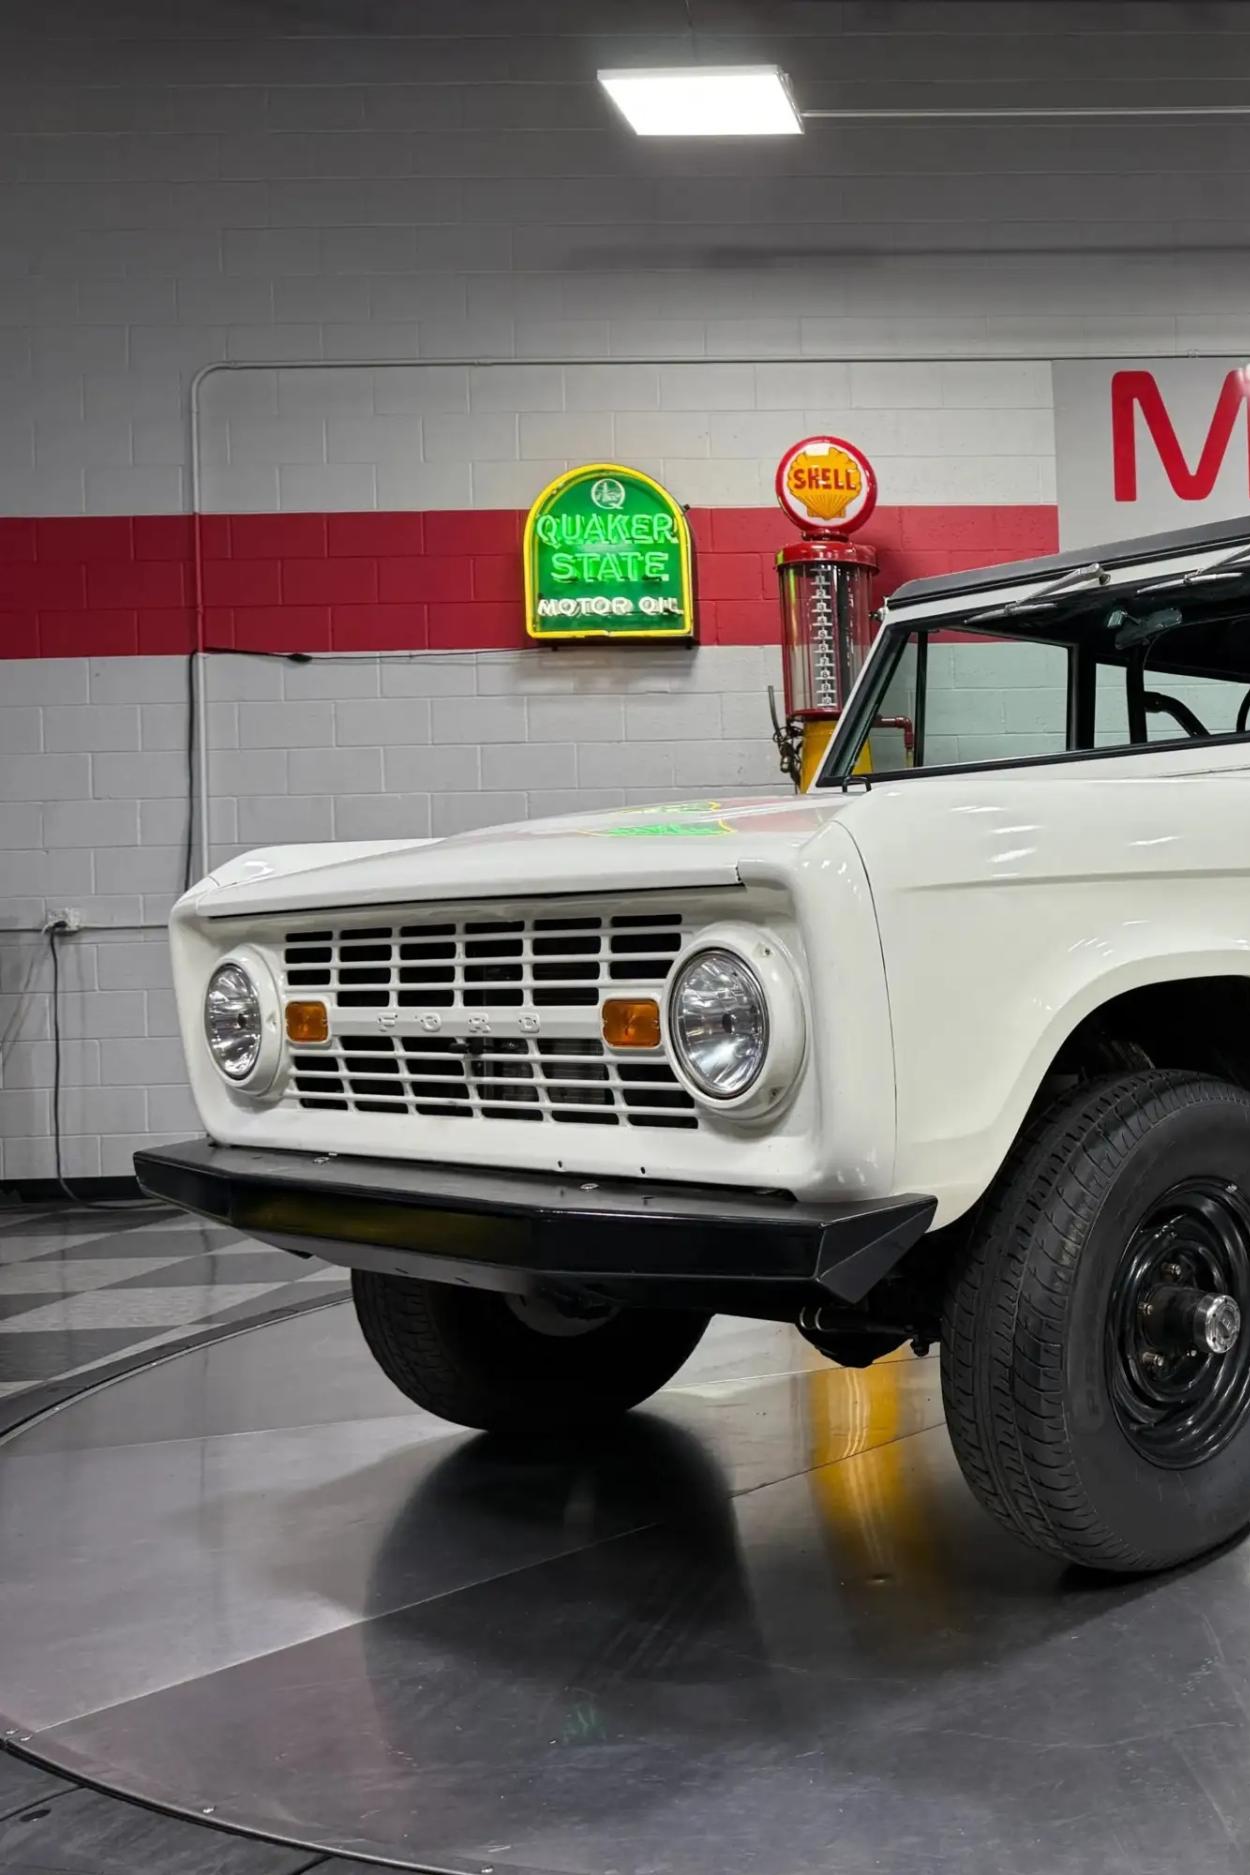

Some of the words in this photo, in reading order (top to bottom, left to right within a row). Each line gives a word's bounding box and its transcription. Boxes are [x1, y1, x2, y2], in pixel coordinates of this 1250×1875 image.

[793, 467, 856, 491] SHELL
[536, 513, 679, 549] QUAKER
[551, 552, 670, 582] STATE
[537, 596, 634, 617] MOTOR
[638, 596, 684, 616] OIL
[377, 1012, 541, 1034] FORD
